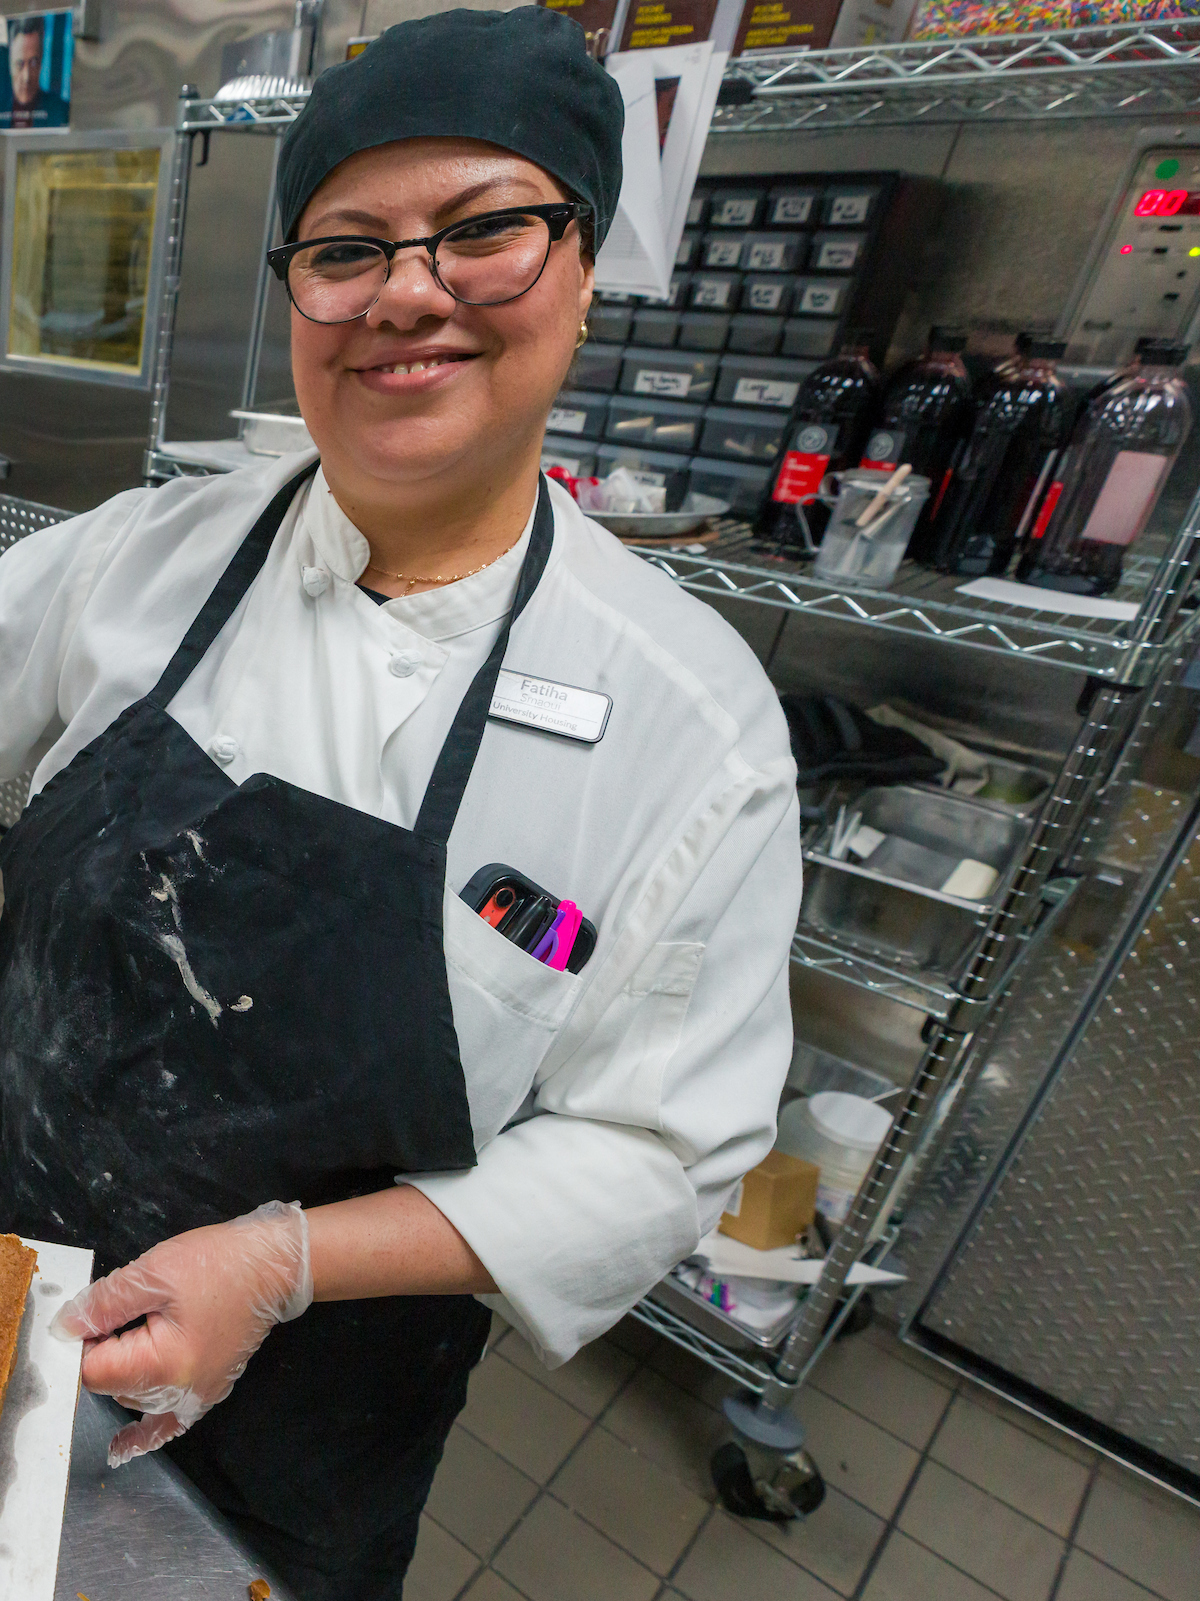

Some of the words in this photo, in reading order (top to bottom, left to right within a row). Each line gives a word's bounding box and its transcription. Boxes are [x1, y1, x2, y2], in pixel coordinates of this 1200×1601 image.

[1134, 189, 1188, 216] 00
[520, 679, 568, 702] Fatiha
[520, 692, 561, 711] Smaoui
[492, 700, 539, 720] University
[539, 711, 578, 732] Housing
